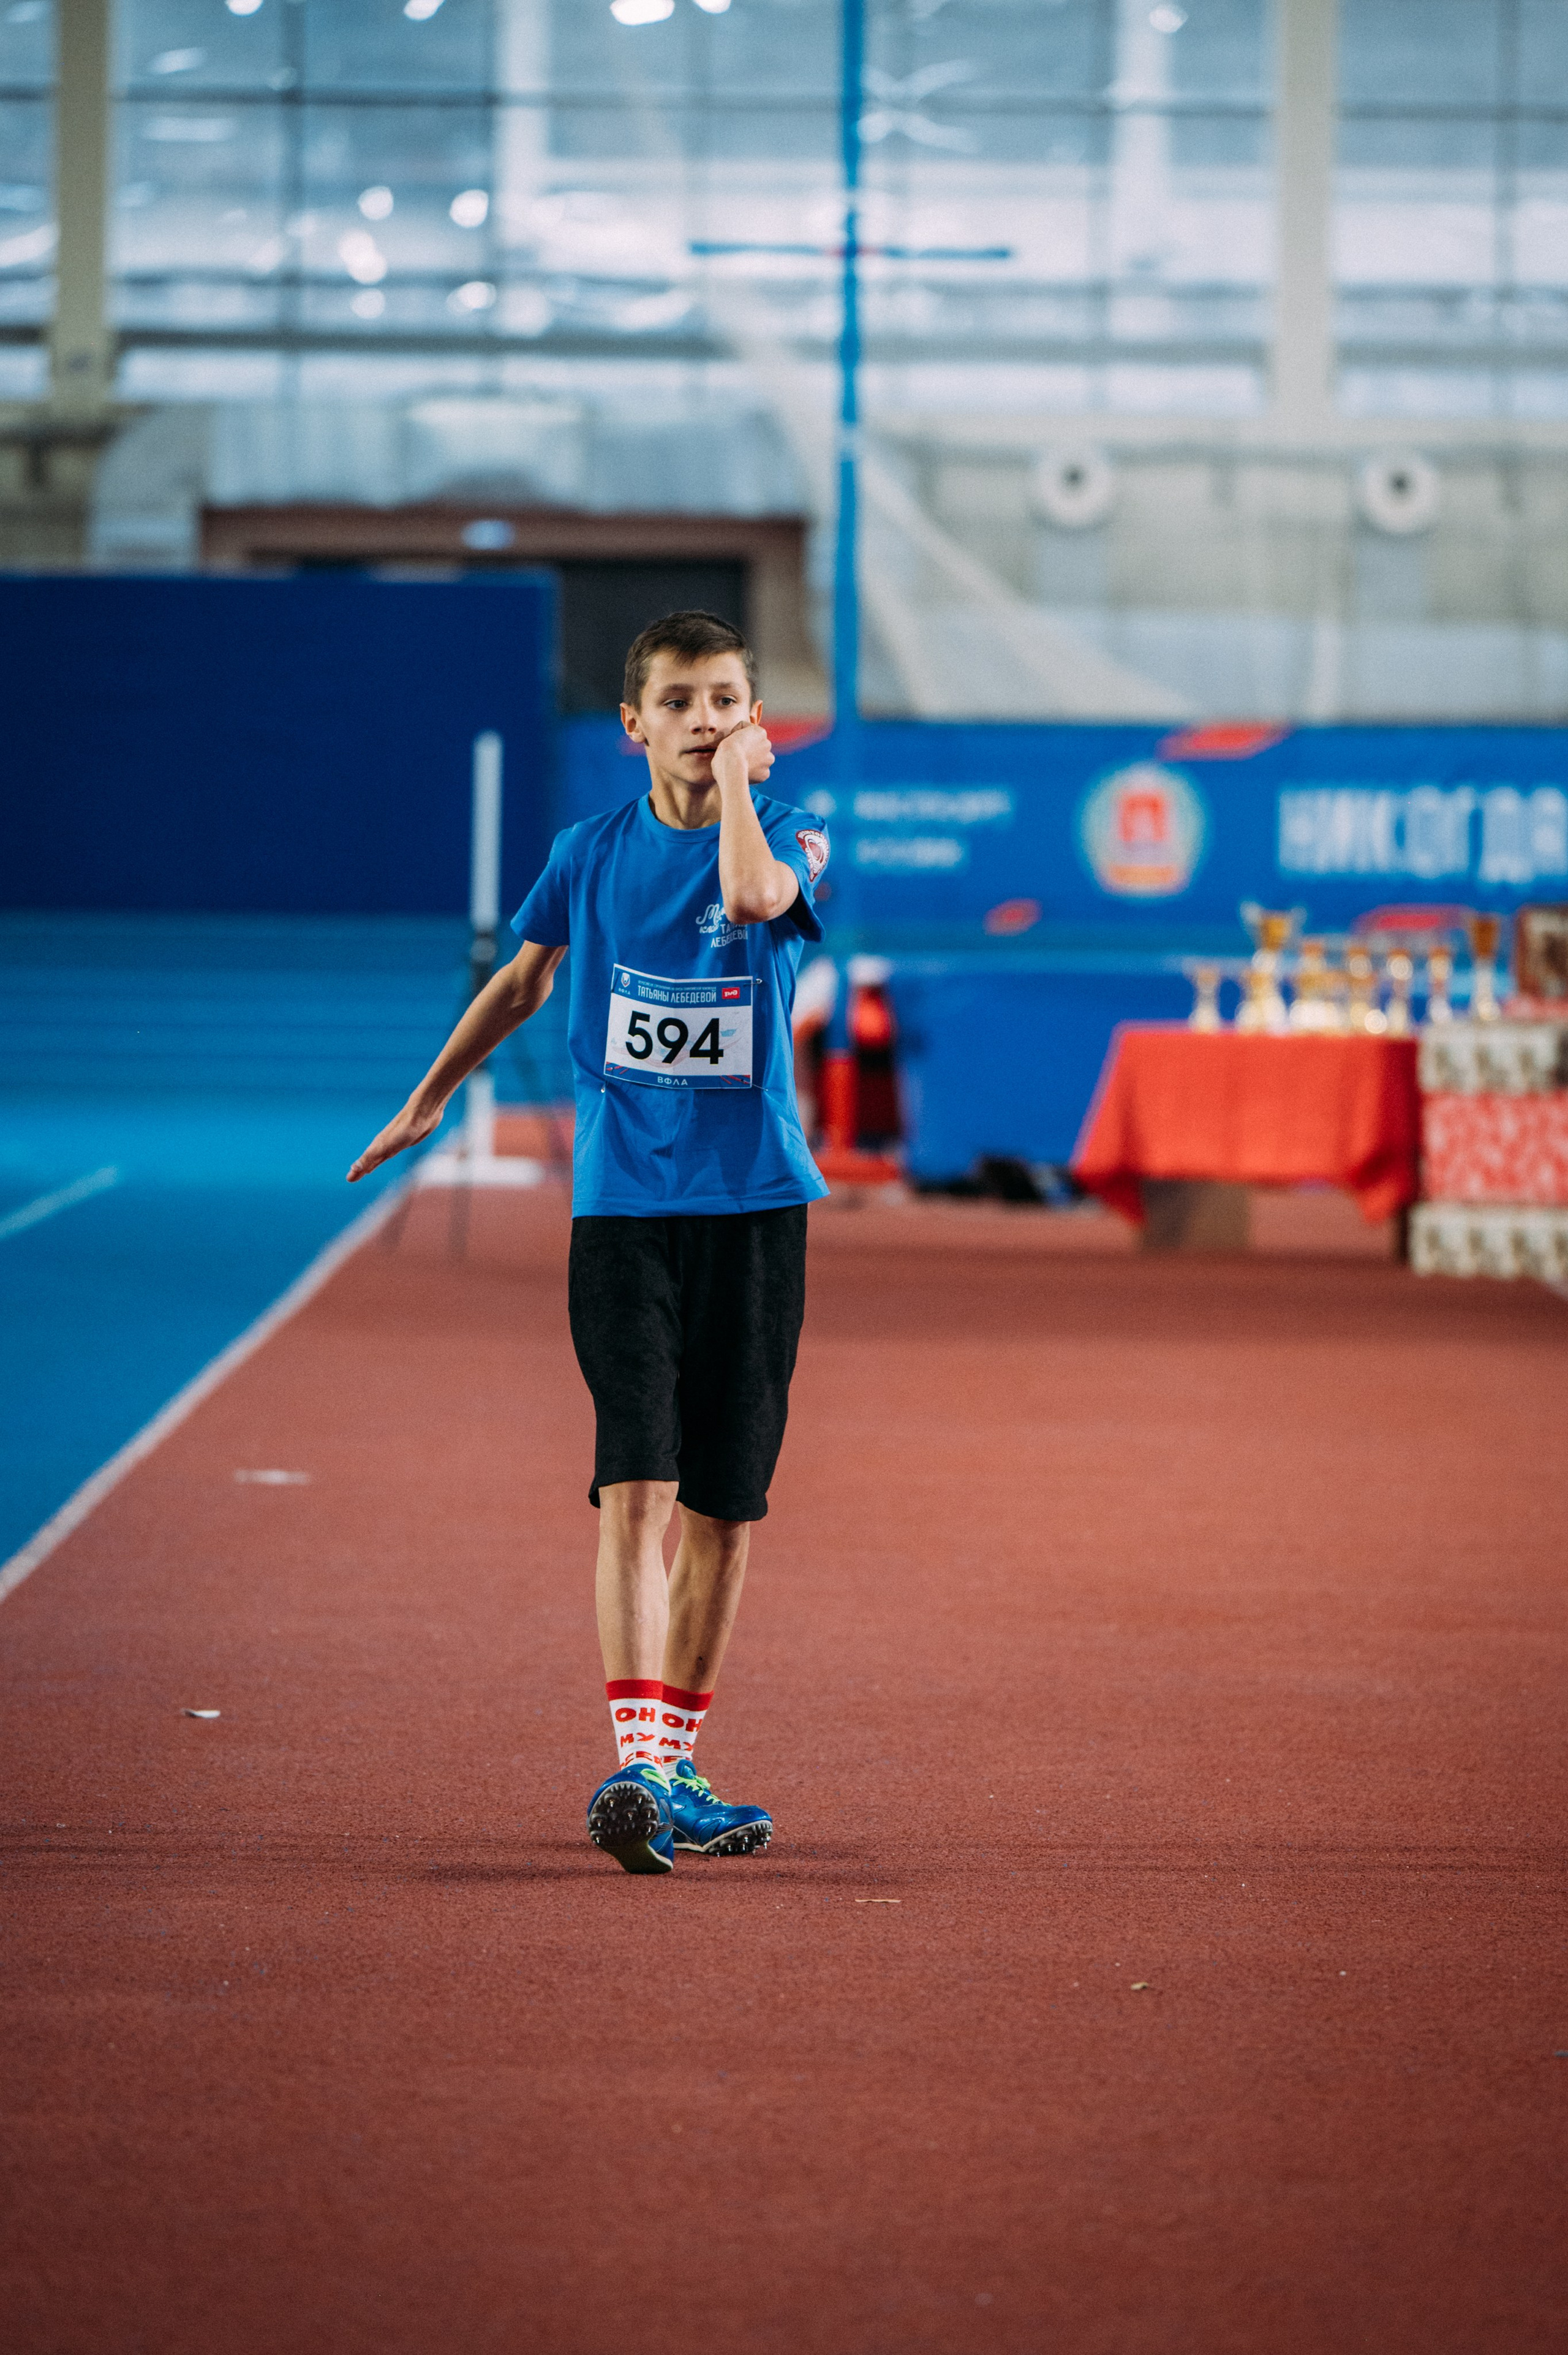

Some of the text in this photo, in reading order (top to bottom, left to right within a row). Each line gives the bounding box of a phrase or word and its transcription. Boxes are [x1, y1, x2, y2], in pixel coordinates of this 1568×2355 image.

[638, 985, 669, 1002] ТАТЬЯНЫ
[671, 989, 717, 1004] ЛЕБЕДЕВОЙ
[625, 1010, 723, 1064] 594
[657, 1076, 688, 1086] ВФЛА
[615, 1707, 655, 1723] OH
[662, 1713, 703, 1732] OH
[620, 1733, 655, 1747] MY
